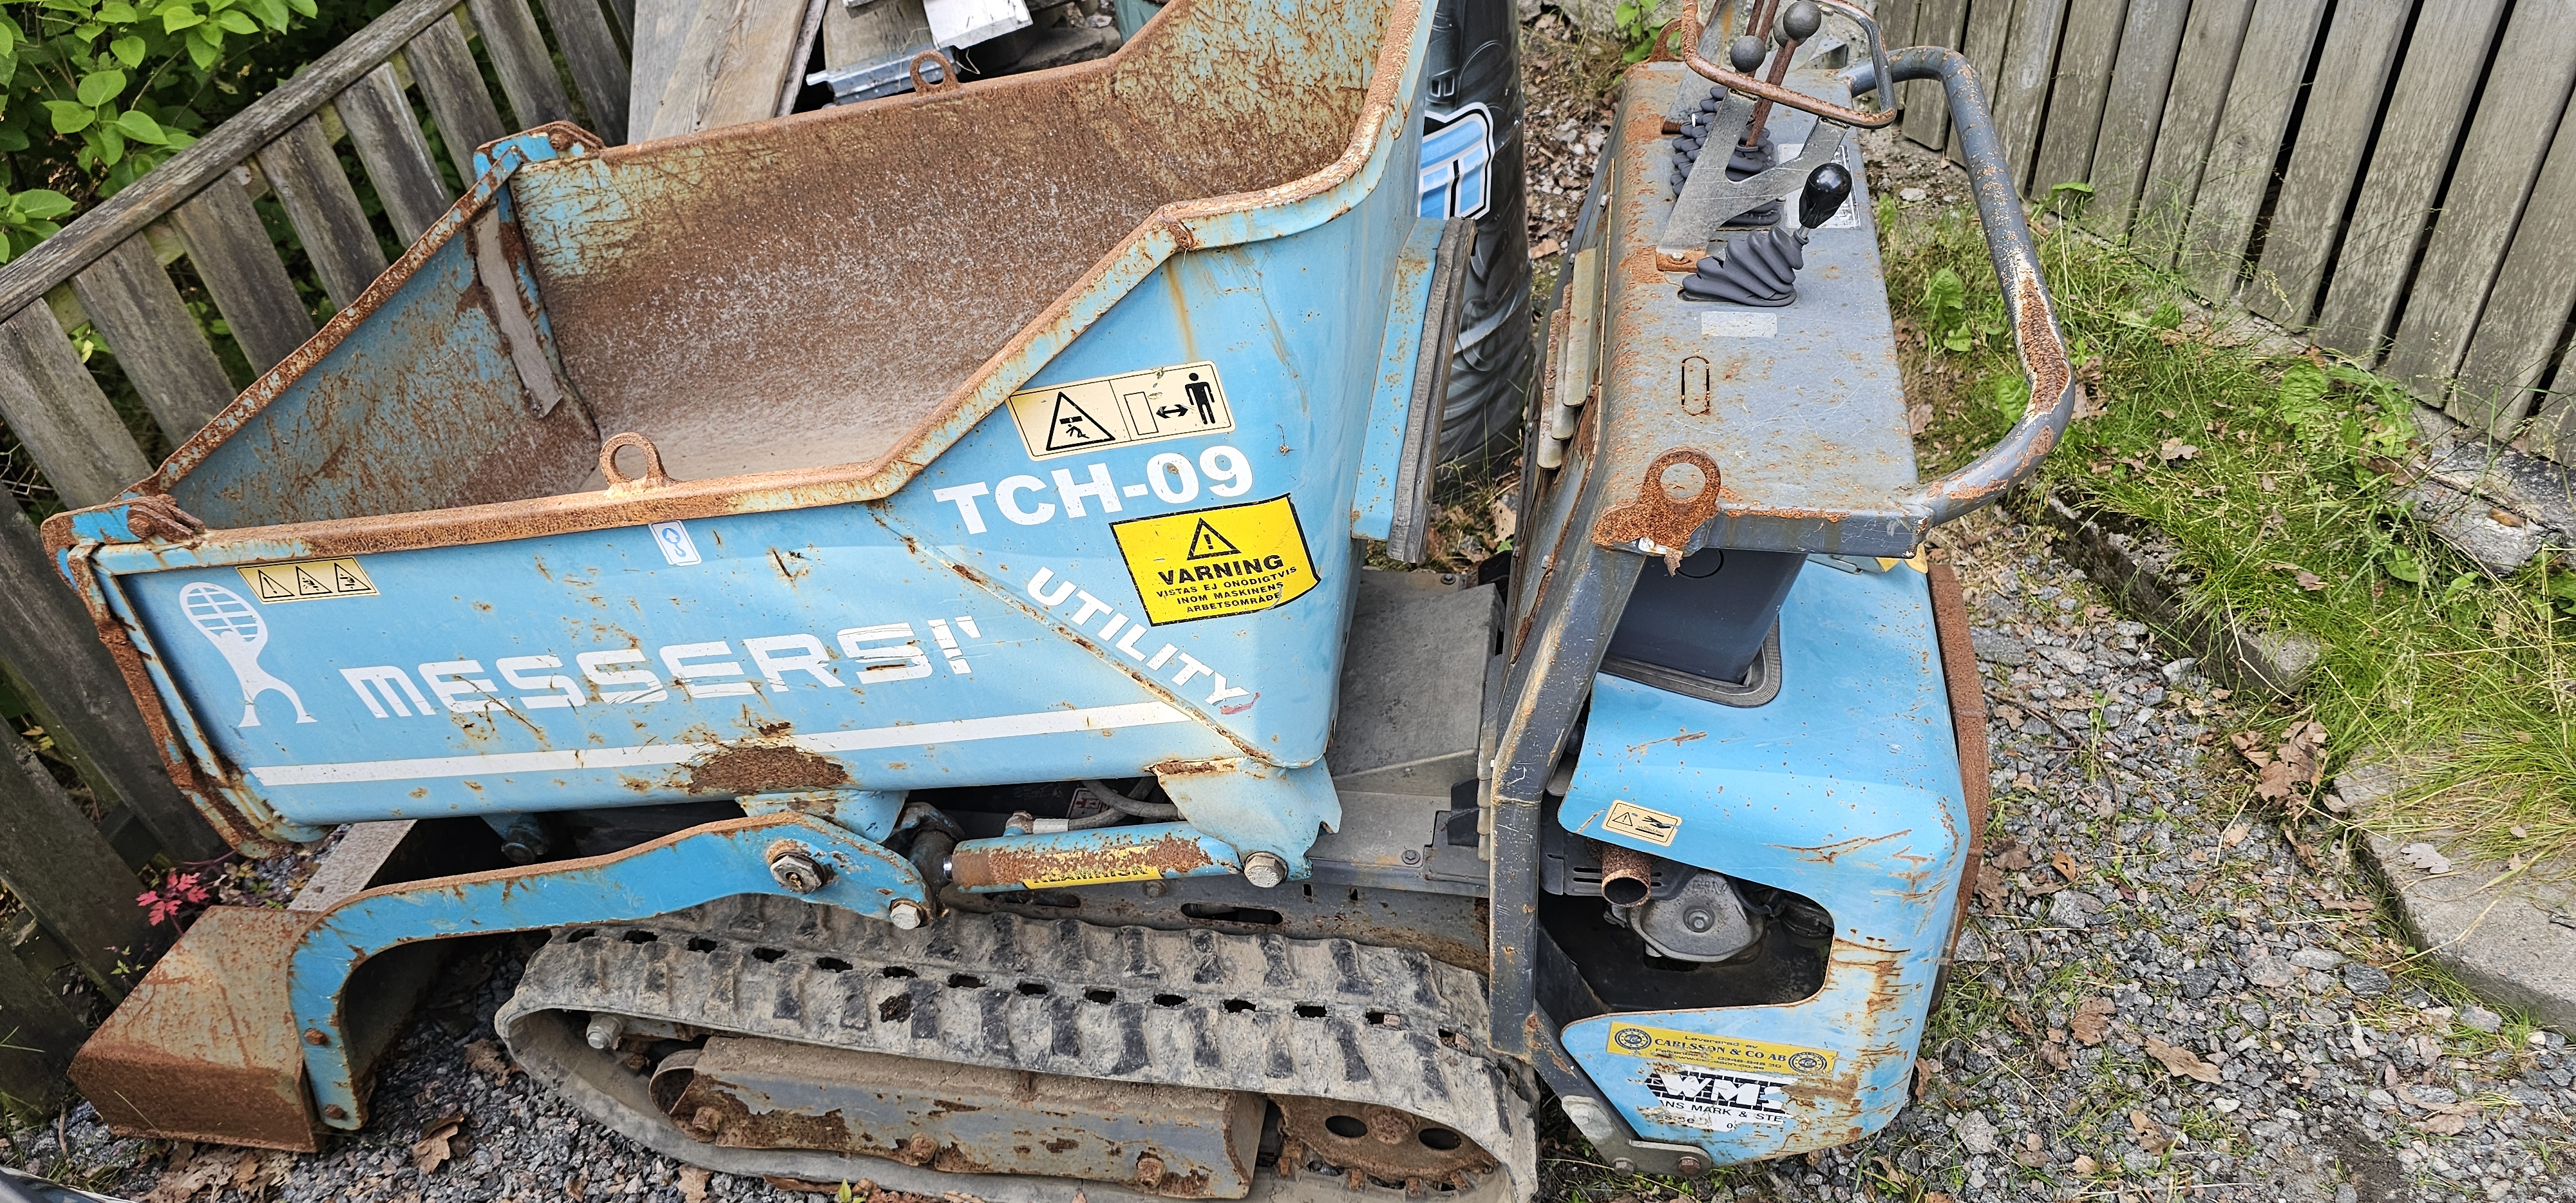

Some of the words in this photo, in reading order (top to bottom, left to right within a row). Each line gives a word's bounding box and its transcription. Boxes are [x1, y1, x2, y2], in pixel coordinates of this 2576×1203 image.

[933, 445, 1254, 535] TCH-09
[1158, 554, 1284, 585] VARNING
[1156, 585, 1198, 598] VISTAS
[1223, 566, 1297, 588] ONÖDIGTVIS
[1177, 594, 1208, 605] INOM
[1215, 582, 1284, 600] MASKINENS
[1186, 591, 1280, 612] ARBETSOMRÅDE
[1027, 567, 1251, 706] UTILITY
[1654, 1039, 1725, 1054] CARLSSON
[1685, 1036, 1739, 1046] Levererad
[1691, 1104, 1732, 1116] MARK
[1756, 1113, 1786, 1123] STE
